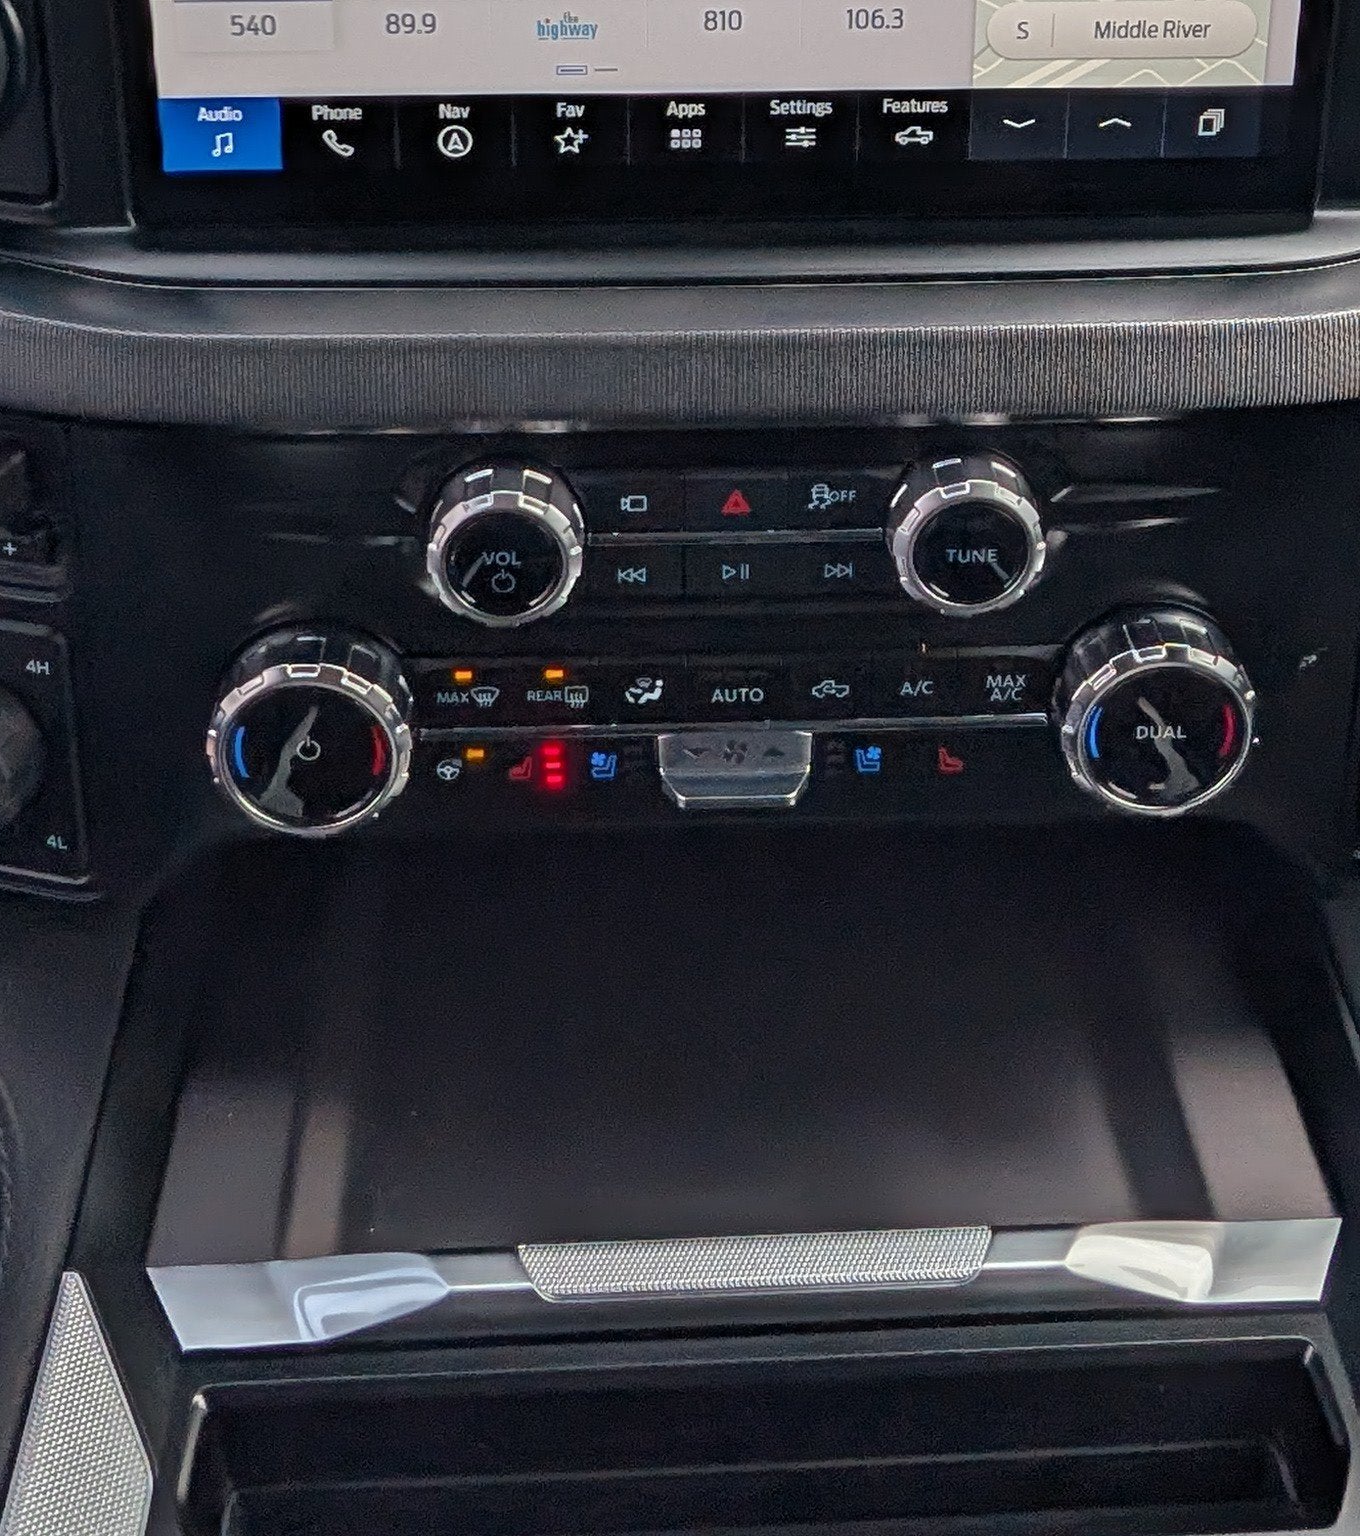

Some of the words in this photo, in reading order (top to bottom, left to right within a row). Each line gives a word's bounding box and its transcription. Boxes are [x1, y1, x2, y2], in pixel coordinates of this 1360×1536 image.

[229, 14, 277, 37] 540
[385, 12, 437, 35] 89.9
[536, 17, 598, 40] highway
[703, 9, 743, 32] 810
[845, 8, 904, 31] 106.3
[1015, 21, 1030, 41] S
[1093, 19, 1158, 40] Middle
[1161, 19, 1211, 40] River
[197, 104, 243, 123] Audio
[311, 104, 363, 122] Phone
[439, 103, 470, 121] Nav
[556, 101, 585, 120] Fav
[666, 100, 706, 120] Apps
[769, 98, 833, 119] Settings
[882, 96, 948, 116] Features
[829, 489, 857, 504] OFF
[482, 551, 522, 567] VOL
[946, 548, 998, 563] TUNE
[25, 659, 50, 675] 4H
[899, 680, 934, 697] A/C
[985, 673, 1027, 689] MAX
[437, 691, 469, 704] MAX
[526, 689, 562, 703] REAR
[710, 687, 765, 704] AUTO
[990, 686, 1022, 702] A/C
[1135, 725, 1187, 740] DUAL
[46, 834, 68, 851] 4L
